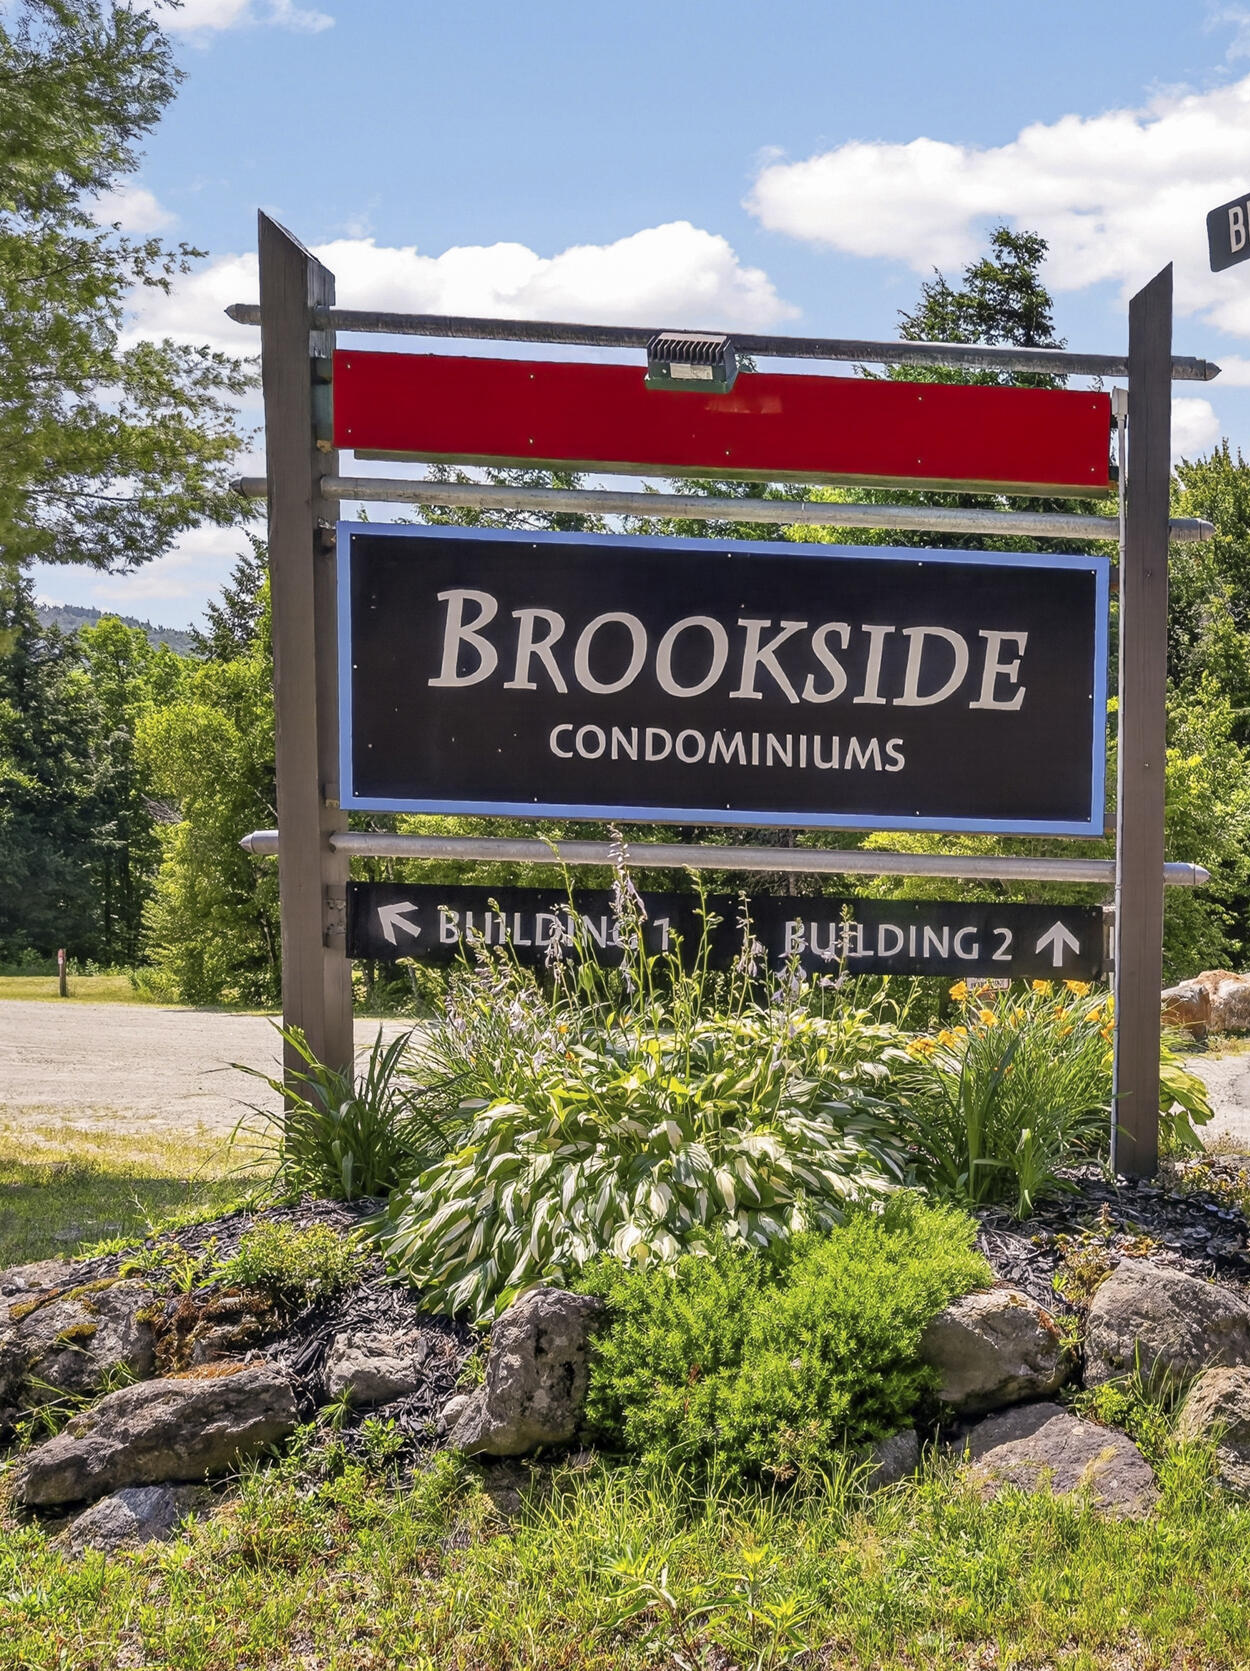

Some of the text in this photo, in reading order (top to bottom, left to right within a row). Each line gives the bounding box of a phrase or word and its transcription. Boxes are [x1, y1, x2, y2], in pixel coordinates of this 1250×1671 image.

[428, 589, 1029, 711] BROOKSIDE
[550, 724, 906, 772] CONDOMINIUMS
[653, 918, 670, 950] 1
[785, 921, 1013, 961] BUILDING 2
